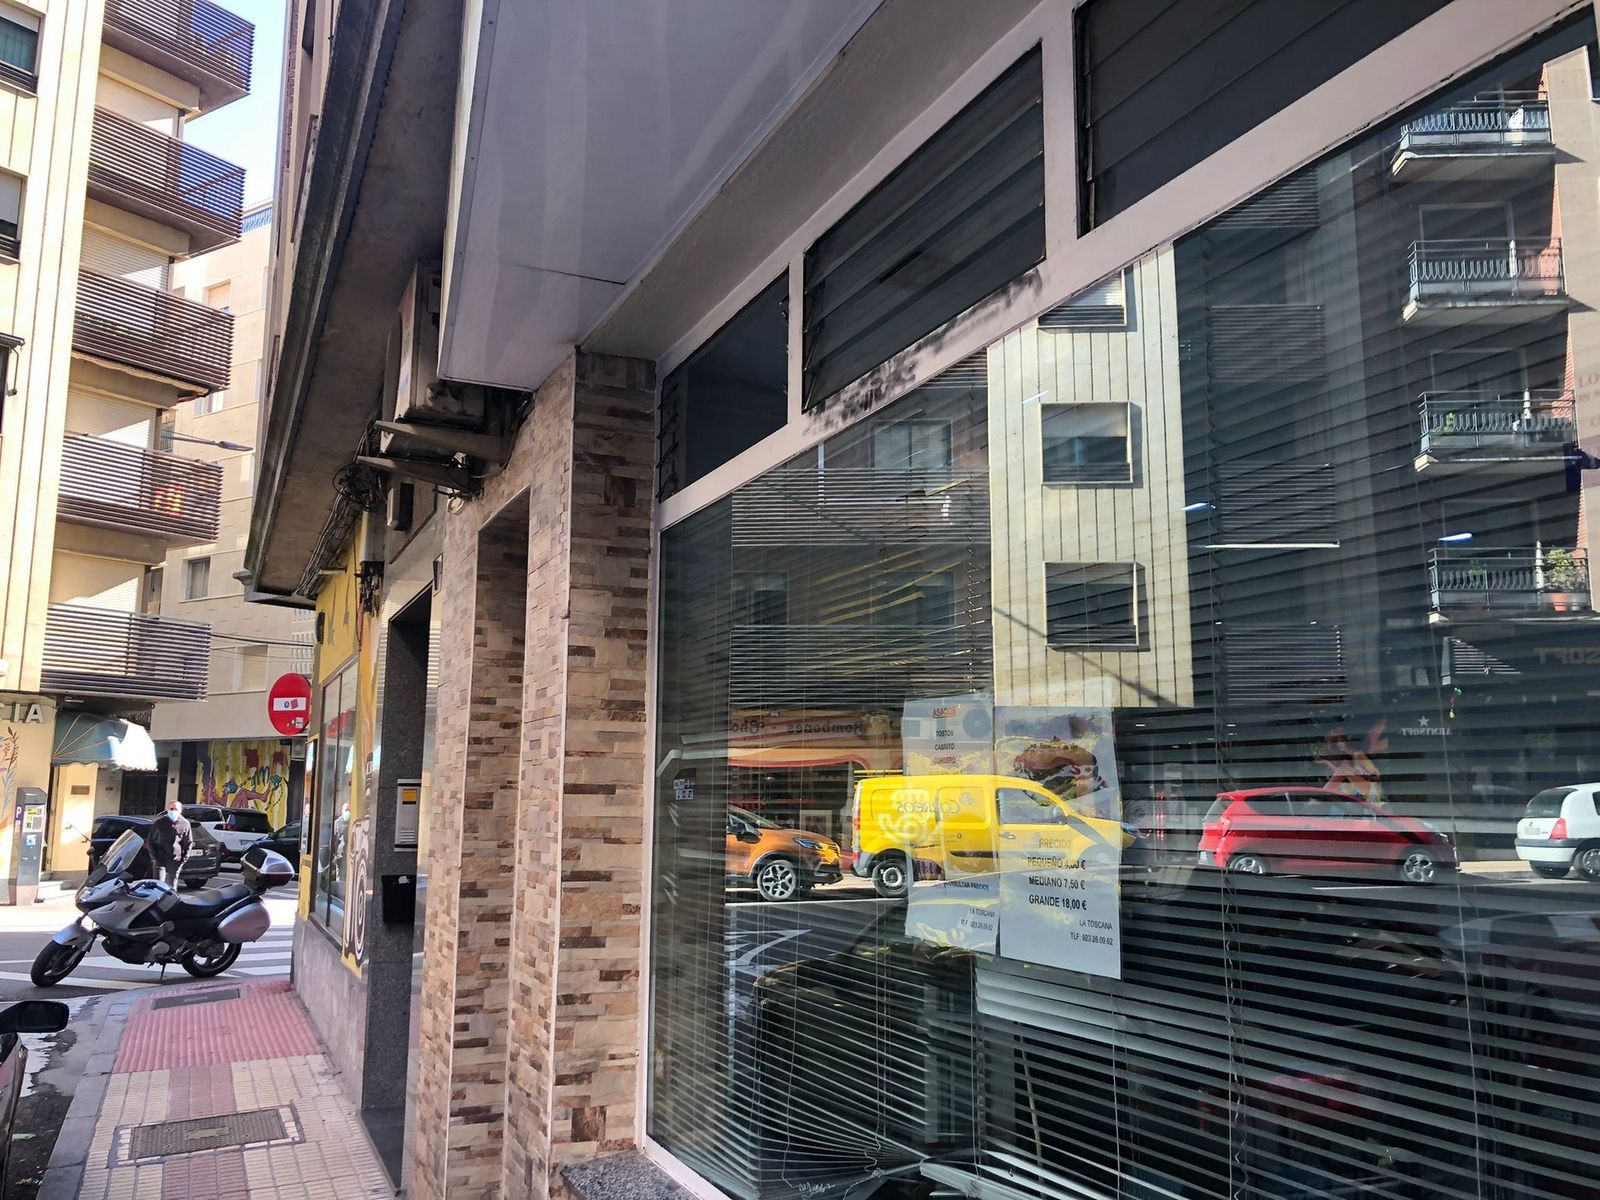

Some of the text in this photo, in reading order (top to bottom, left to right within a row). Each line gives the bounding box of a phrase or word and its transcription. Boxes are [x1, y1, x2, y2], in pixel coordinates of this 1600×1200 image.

[934, 742, 955, 751] CABRITO
[933, 756, 957, 765] CORDERO
[1038, 838, 1073, 849] PRECIOS
[1027, 855, 1062, 869] PEQUEÑO
[1081, 859, 1086, 870] €
[1028, 875, 1086, 891] MEDIANO 7,50 €
[1028, 894, 1087, 911] GRANDE 18,00 €
[1079, 919, 1113, 930] LA TOSCANA
